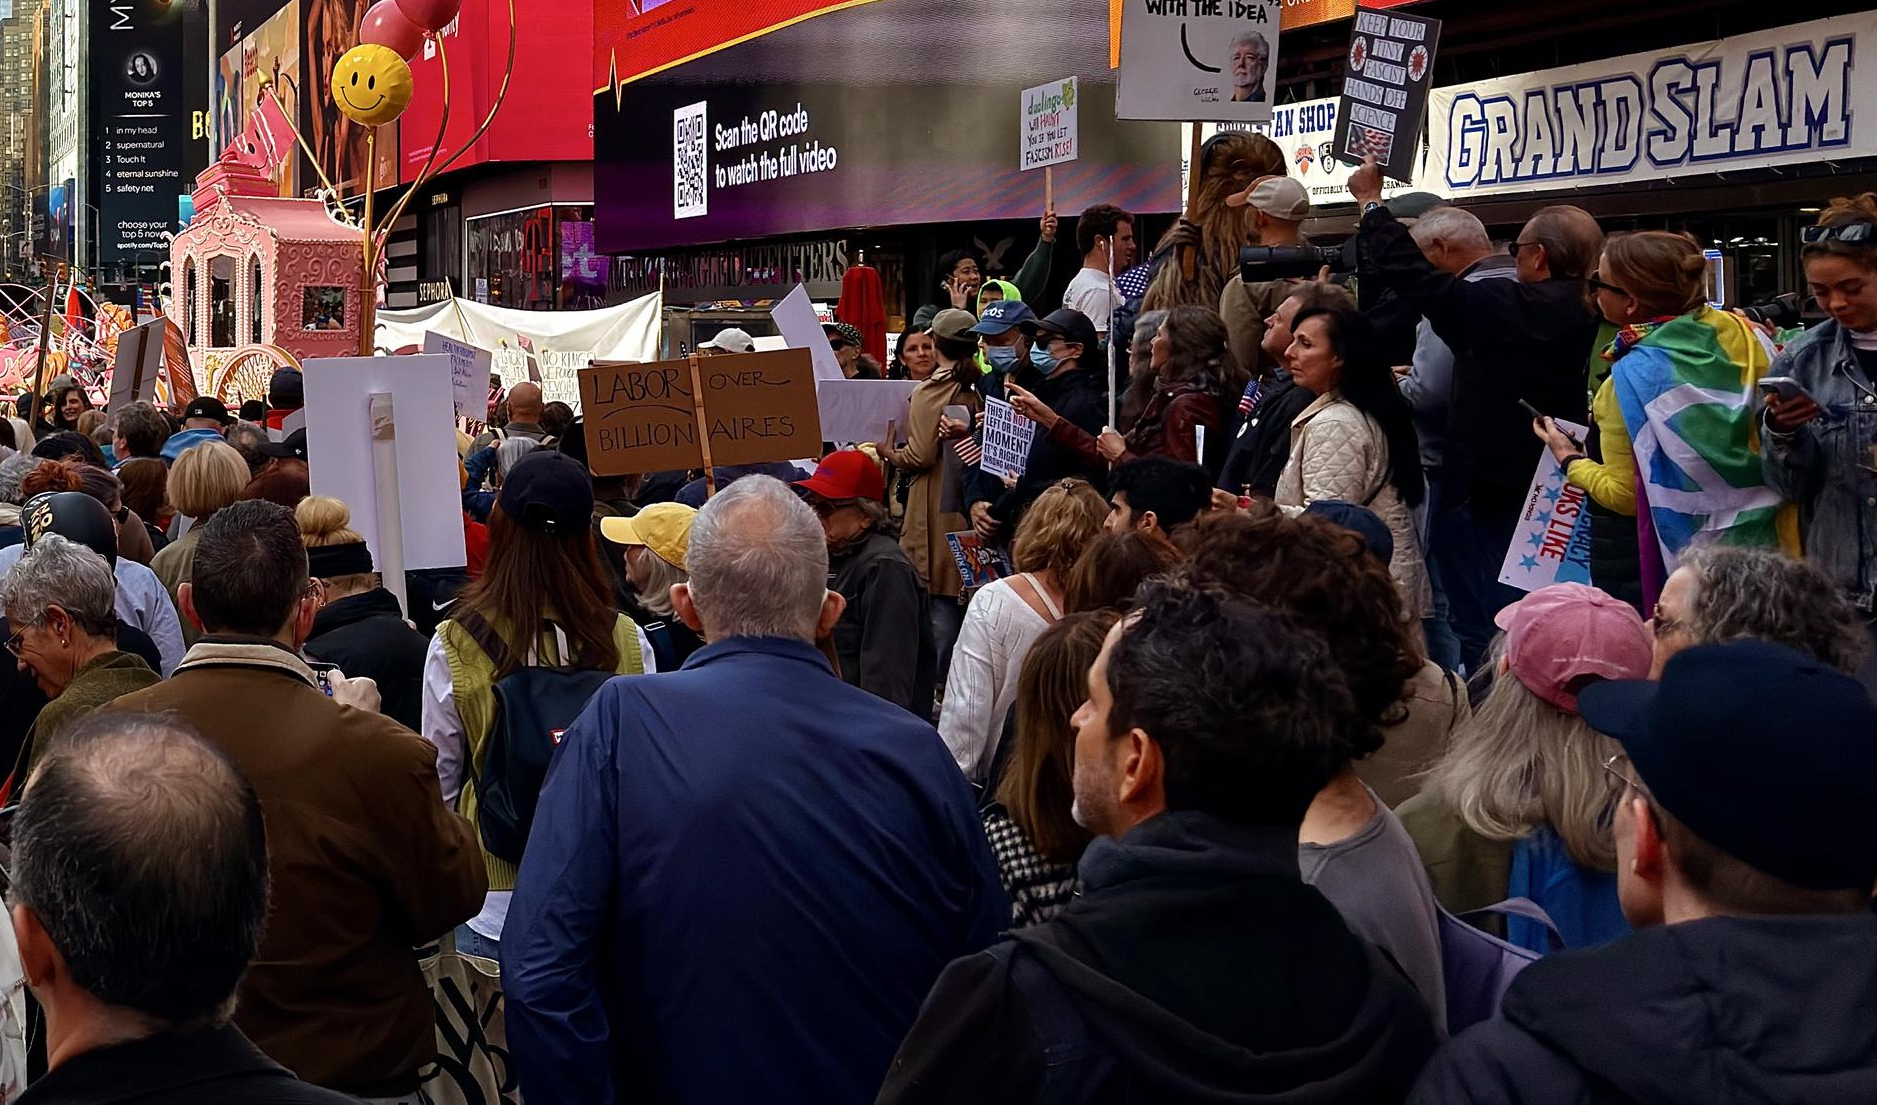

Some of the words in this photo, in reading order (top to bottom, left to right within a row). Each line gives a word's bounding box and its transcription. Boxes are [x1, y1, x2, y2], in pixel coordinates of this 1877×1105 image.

[1358, 12, 1388, 35] KEEP
[1391, 18, 1424, 40] YOUR
[1365, 59, 1407, 85] FASCIST
[1028, 90, 1061, 115] duolingo
[1345, 78, 1384, 103] HANDS
[1385, 89, 1407, 109] OFF
[715, 119, 740, 151] Scan
[741, 116, 758, 144] the
[760, 110, 778, 141] QR
[779, 103, 808, 136] code
[1298, 103, 1335, 135] SHOP
[1351, 104, 1396, 130] SCIENCE
[138, 126, 157, 134] head
[116, 141, 165, 150] supernatural
[1026, 145, 1053, 166] FASCISM
[116, 155, 140, 163] Touch
[716, 164, 726, 188] to
[727, 155, 758, 186] watch
[760, 150, 777, 180] the
[779, 144, 798, 176] full
[799, 140, 837, 174] video
[116, 170, 144, 178] eternal
[144, 170, 179, 178] sunshine
[116, 184, 140, 193] safety
[117, 221, 148, 229] choose
[148, 222, 168, 231] your
[122, 231, 136, 240] top
[419, 282, 450, 301] SEPHORA
[542, 351, 557, 367] NO
[593, 368, 692, 405] LABOR
[709, 371, 791, 390] OVER
[986, 415, 1001, 429] LEFT
[987, 404, 1003, 419] THIS
[599, 423, 693, 452] BILLION
[709, 416, 795, 440] AIRES
[985, 428, 1028, 455] MOMENT
[984, 443, 997, 456] IT'S
[998, 448, 1019, 464] RIGHT
[1540, 519, 1575, 562] LIKE
